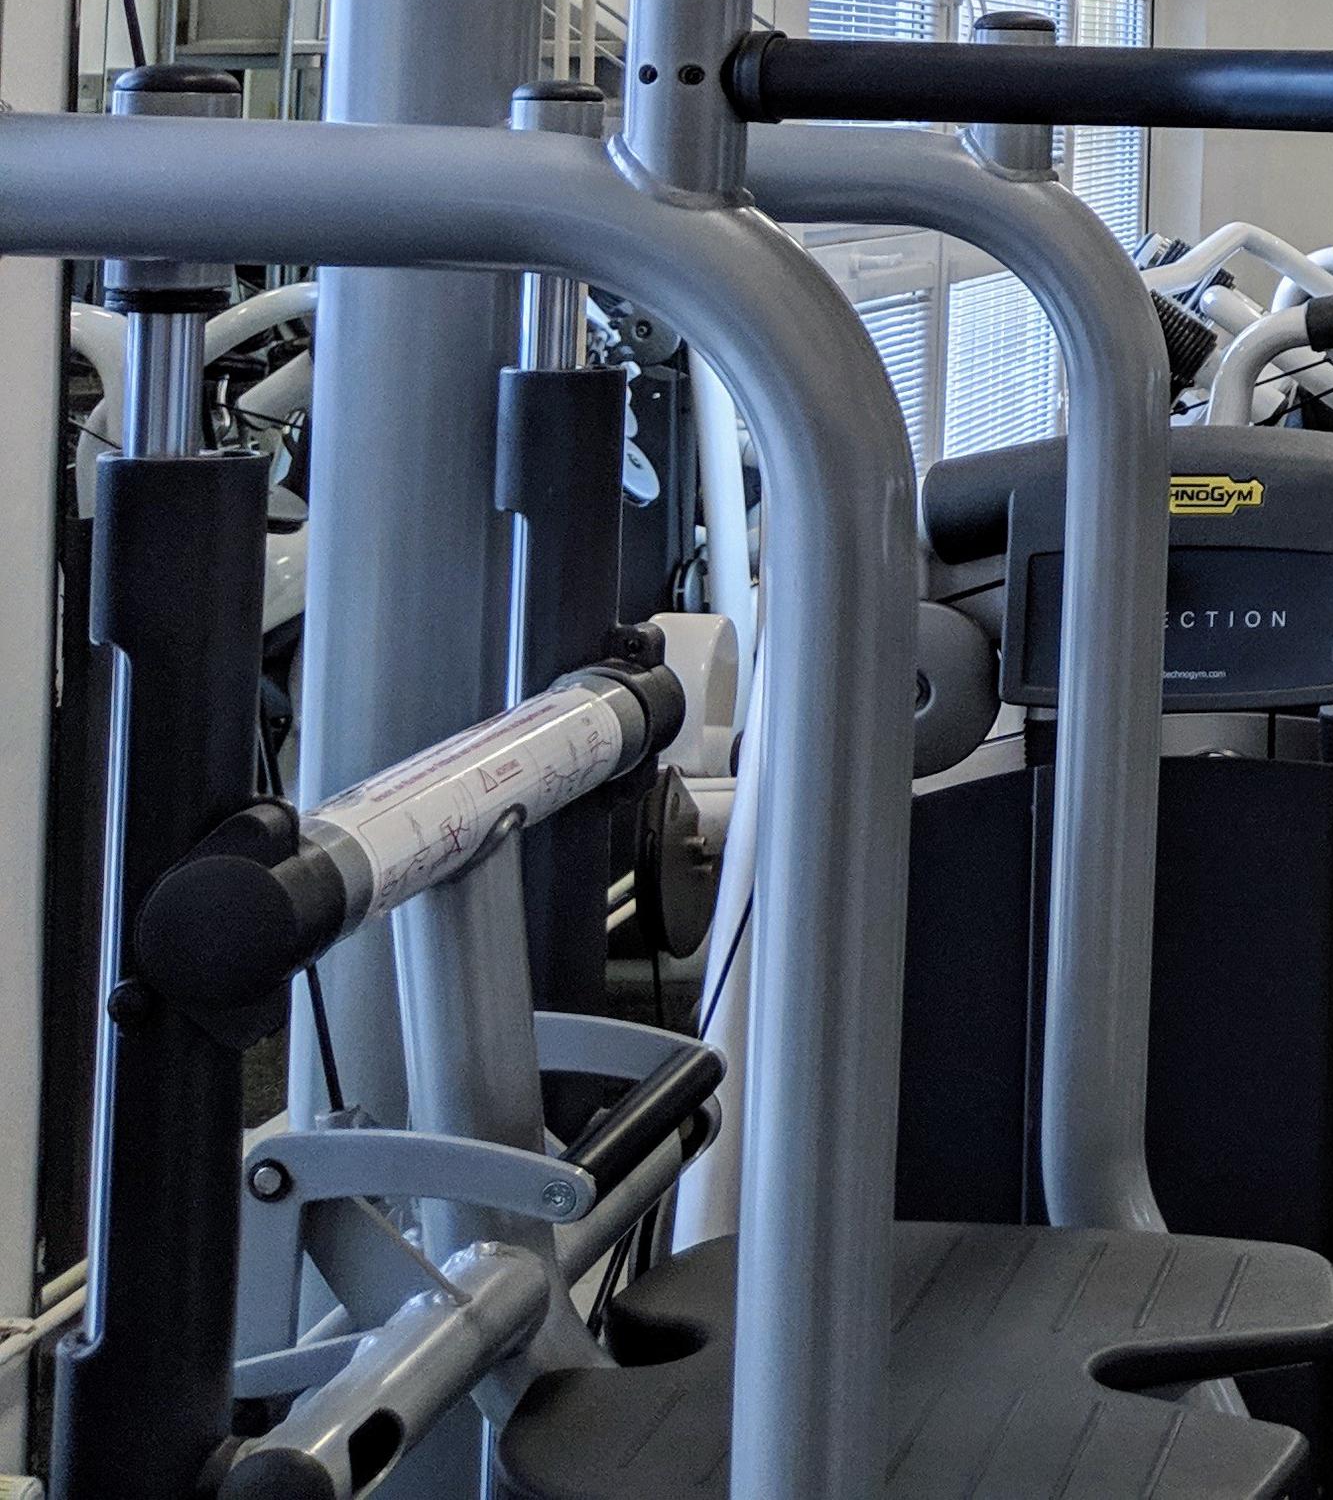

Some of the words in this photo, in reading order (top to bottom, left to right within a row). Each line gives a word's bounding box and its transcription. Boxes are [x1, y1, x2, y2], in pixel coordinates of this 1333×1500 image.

[1170, 484, 1254, 501] HNOGYM
[1162, 611, 1287, 628] ECTION
[1163, 670, 1226, 681] technogym.com
